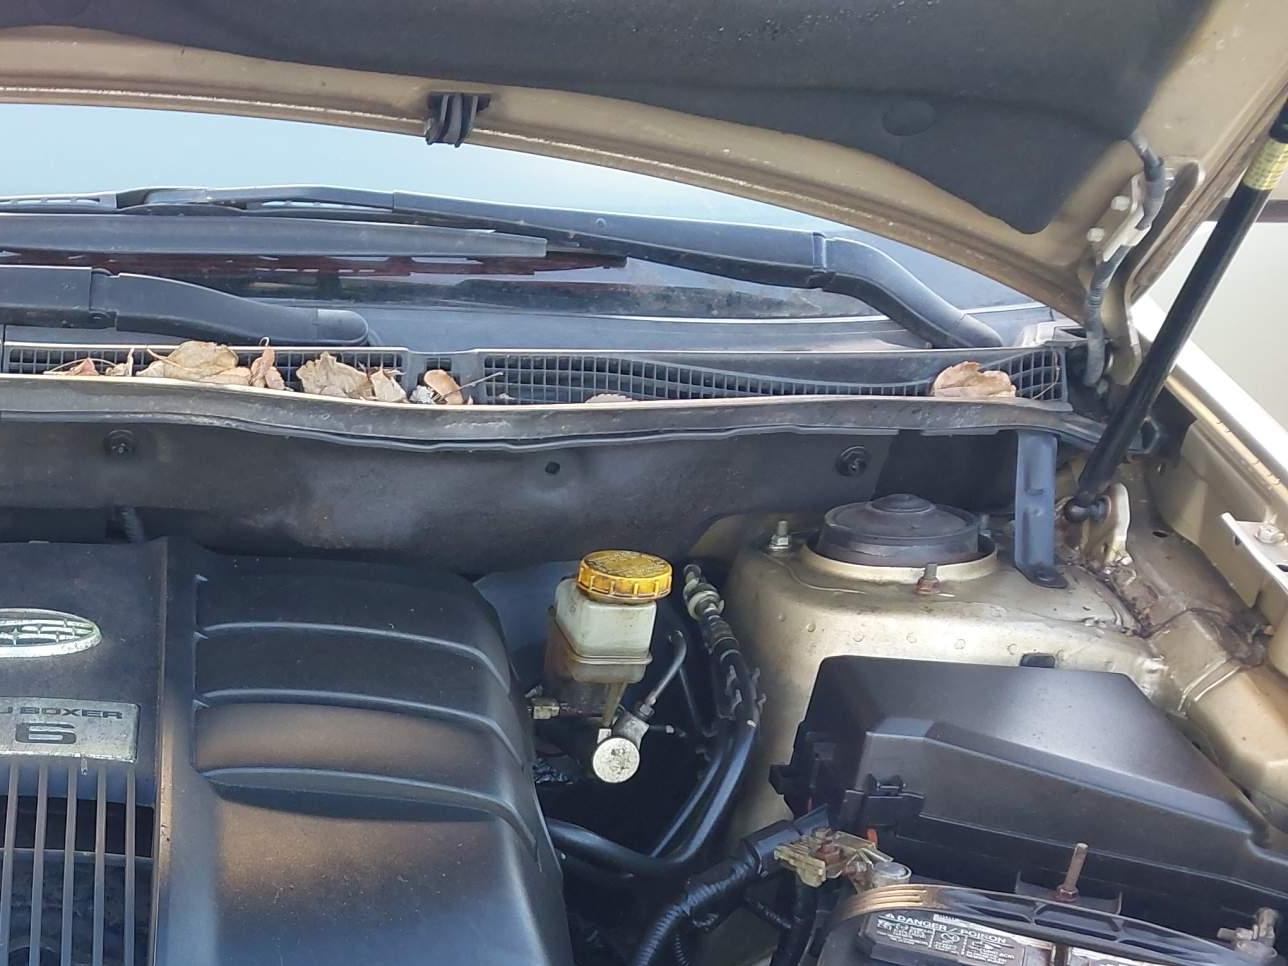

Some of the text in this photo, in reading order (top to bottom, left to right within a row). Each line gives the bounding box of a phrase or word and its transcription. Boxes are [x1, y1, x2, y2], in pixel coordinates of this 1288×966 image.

[19, 705, 123, 719] BOXER
[896, 914, 947, 932] DANGER
[958, 928, 1007, 944] POISON
